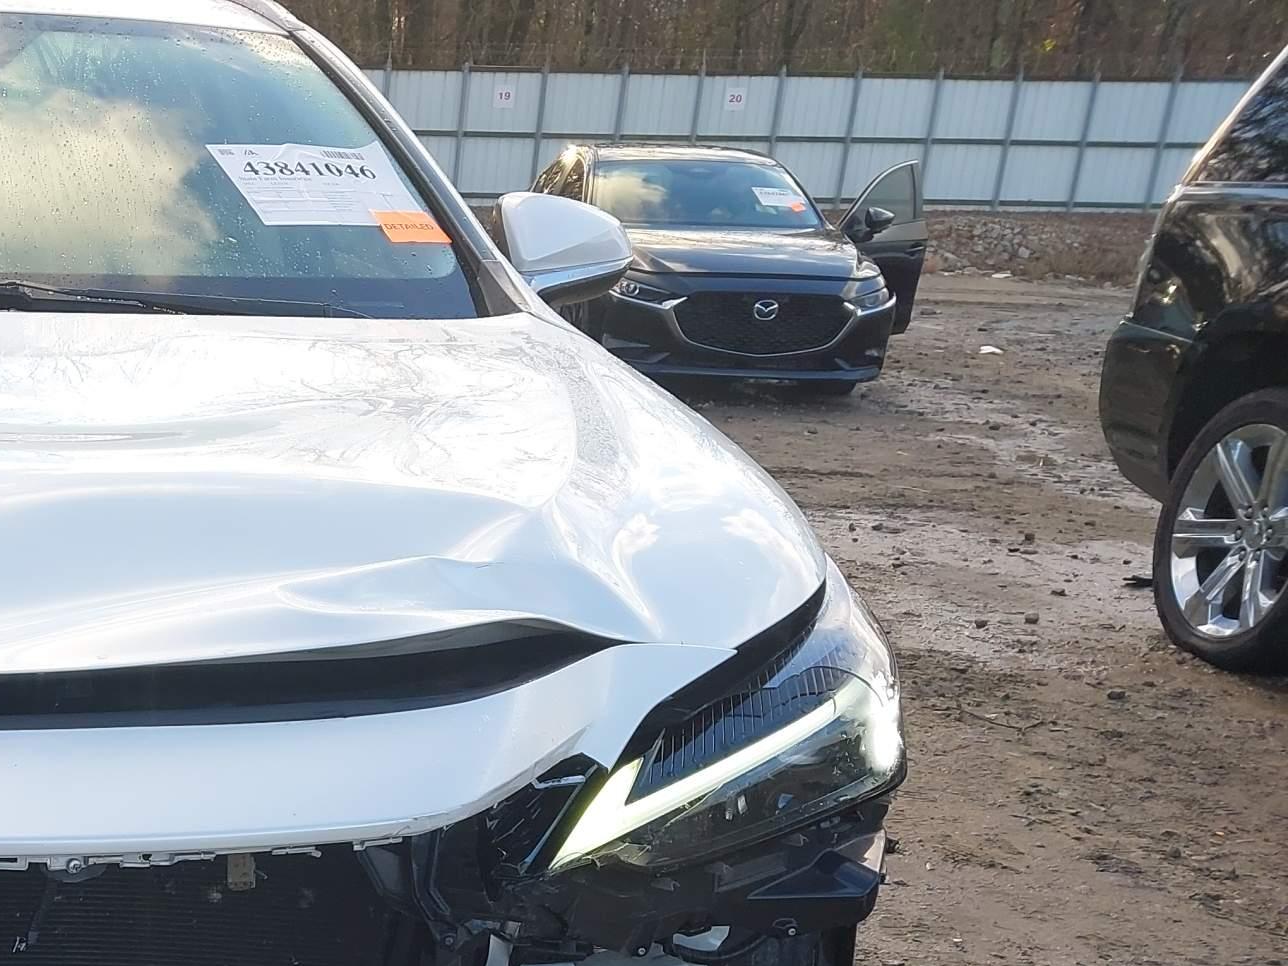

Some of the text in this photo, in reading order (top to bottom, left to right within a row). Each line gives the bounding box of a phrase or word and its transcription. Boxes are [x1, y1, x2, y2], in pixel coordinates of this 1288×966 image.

[498, 91, 511, 101] 19
[728, 94, 743, 104] 20
[243, 160, 377, 180] 43841046
[384, 223, 434, 231] DETAILED
